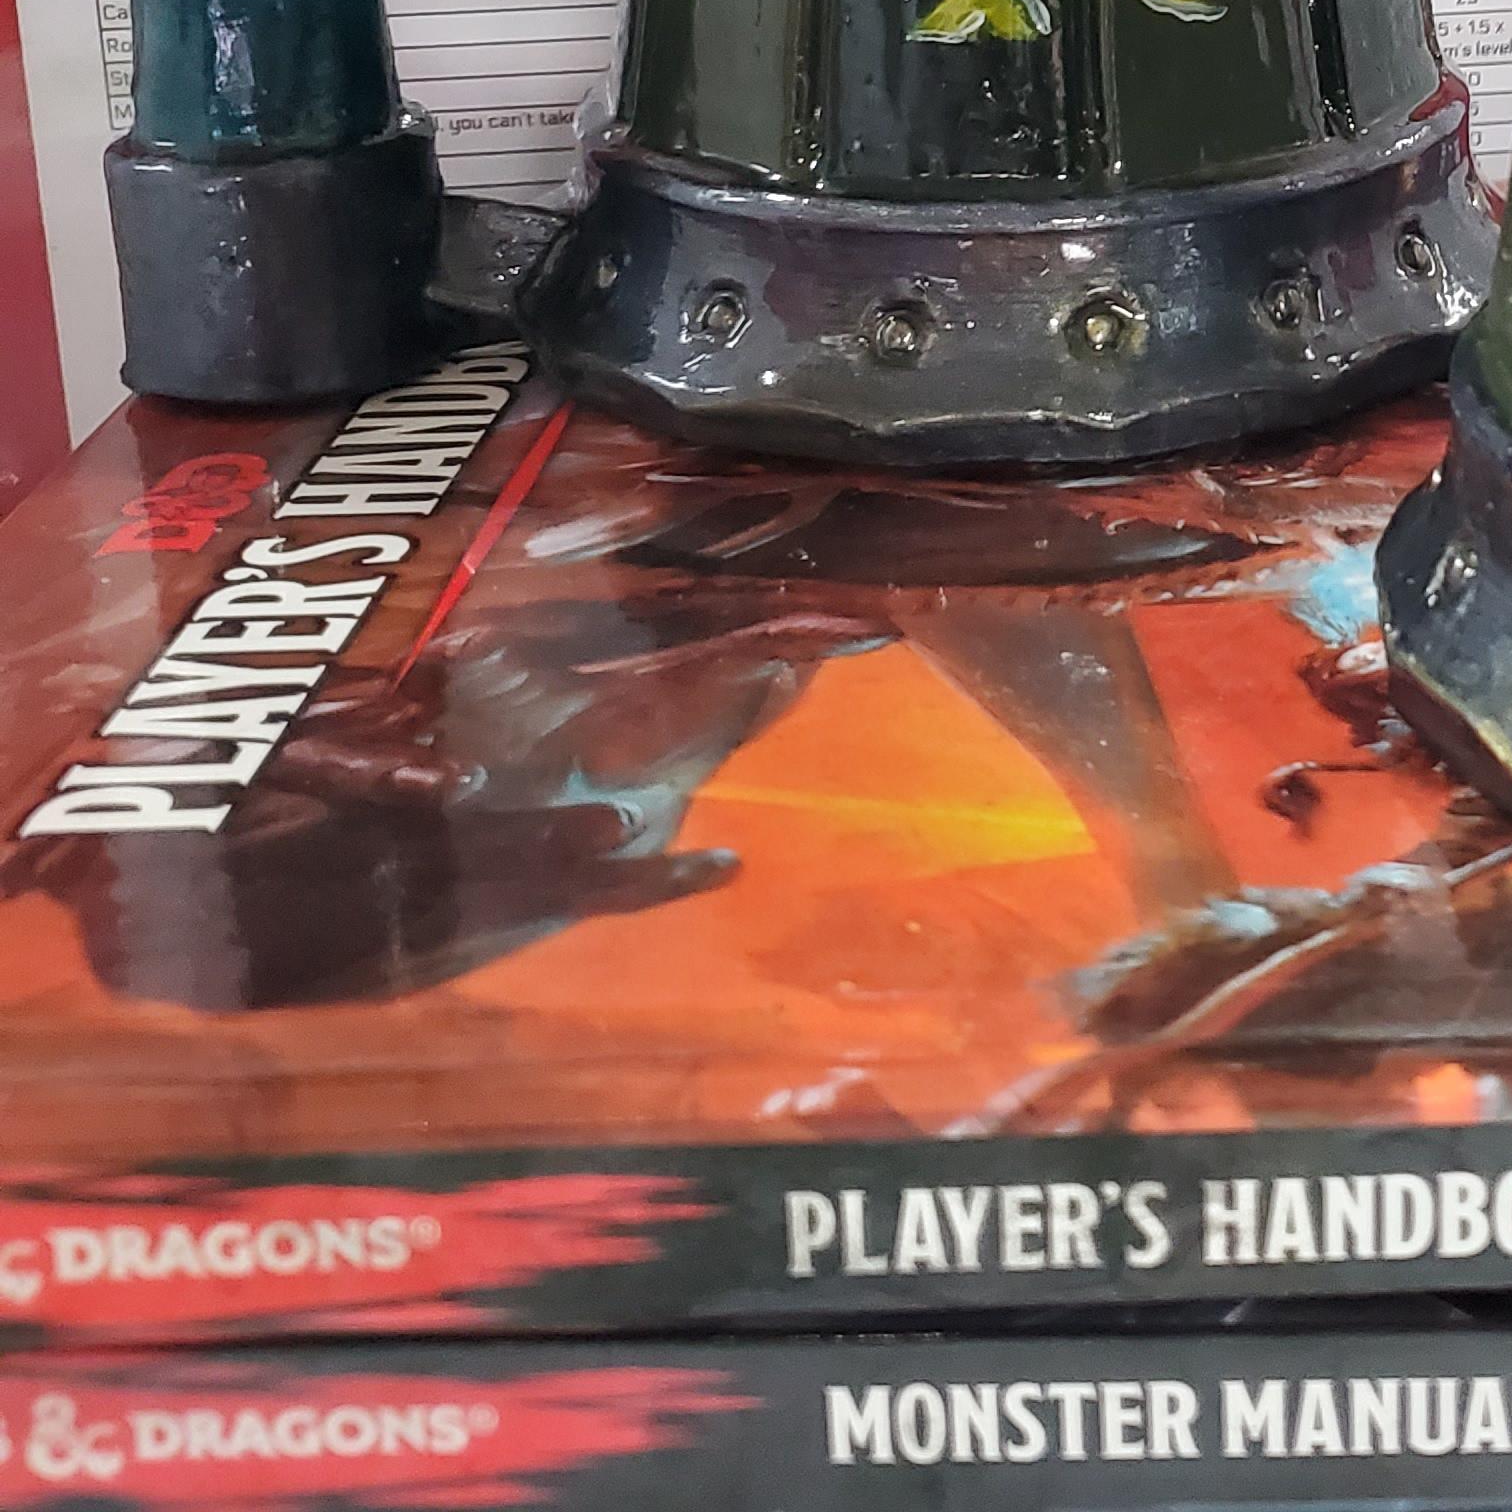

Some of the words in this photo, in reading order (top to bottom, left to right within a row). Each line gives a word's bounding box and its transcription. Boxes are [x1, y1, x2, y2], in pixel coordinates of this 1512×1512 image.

[19, 533, 413, 840] PLAYER'S
[273, 340, 531, 520] HANDB
[784, 1180, 1170, 1277] PLAYER'S
[824, 1381, 1202, 1465] MONSTER
